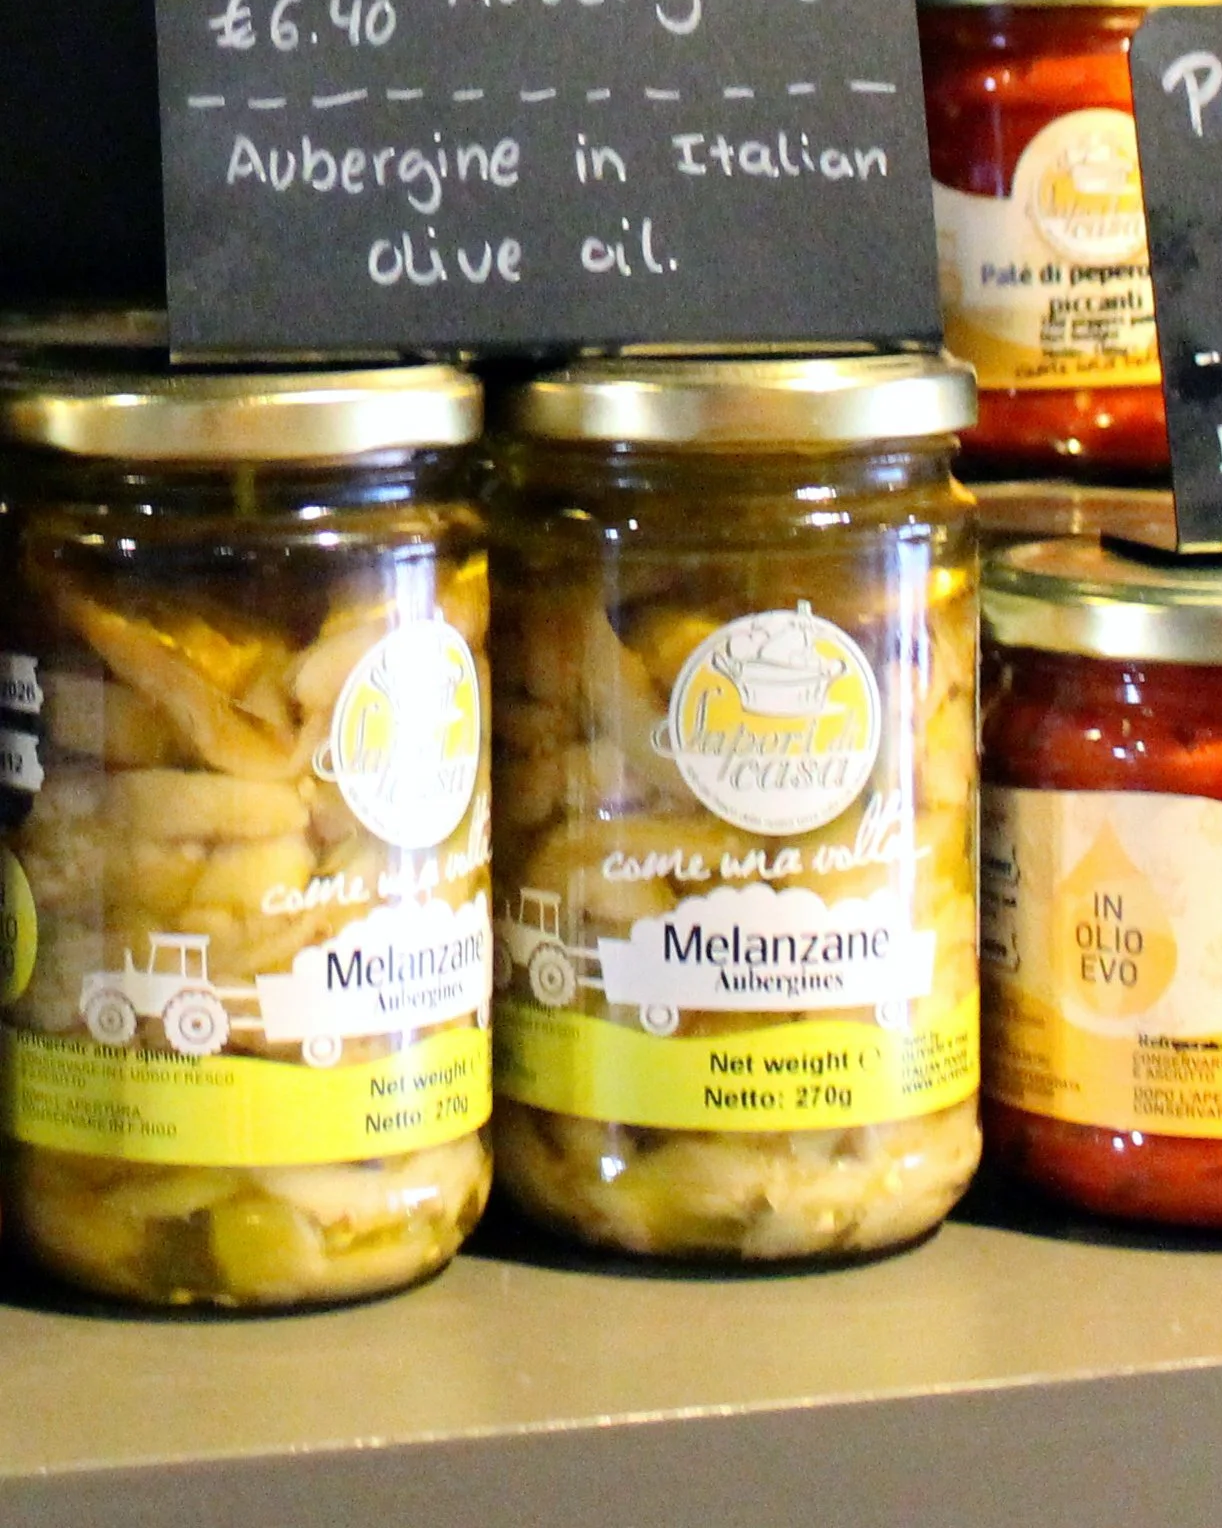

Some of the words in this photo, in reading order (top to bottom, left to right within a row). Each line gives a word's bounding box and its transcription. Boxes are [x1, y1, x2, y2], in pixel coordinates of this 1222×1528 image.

[225, 133, 521, 214] Aubergine
[575, 133, 627, 183] in
[673, 131, 889, 179] Italian
[580, 217, 678, 277] oil.
[1094, 892, 1124, 921] IN
[663, 922, 891, 967] Melanzane
[1075, 922, 1144, 956] OLIO
[327, 929, 485, 991] Melanzane
[1080, 956, 1139, 988] EVO
[714, 971, 845, 996] Aubergines
[371, 1074, 405, 1099] Net
[413, 1058, 466, 1090] weight
[709, 1052, 754, 1074] Net
[764, 1048, 849, 1076] weight
[704, 1087, 785, 1110] Netto:
[795, 1085, 853, 1110] 270g
